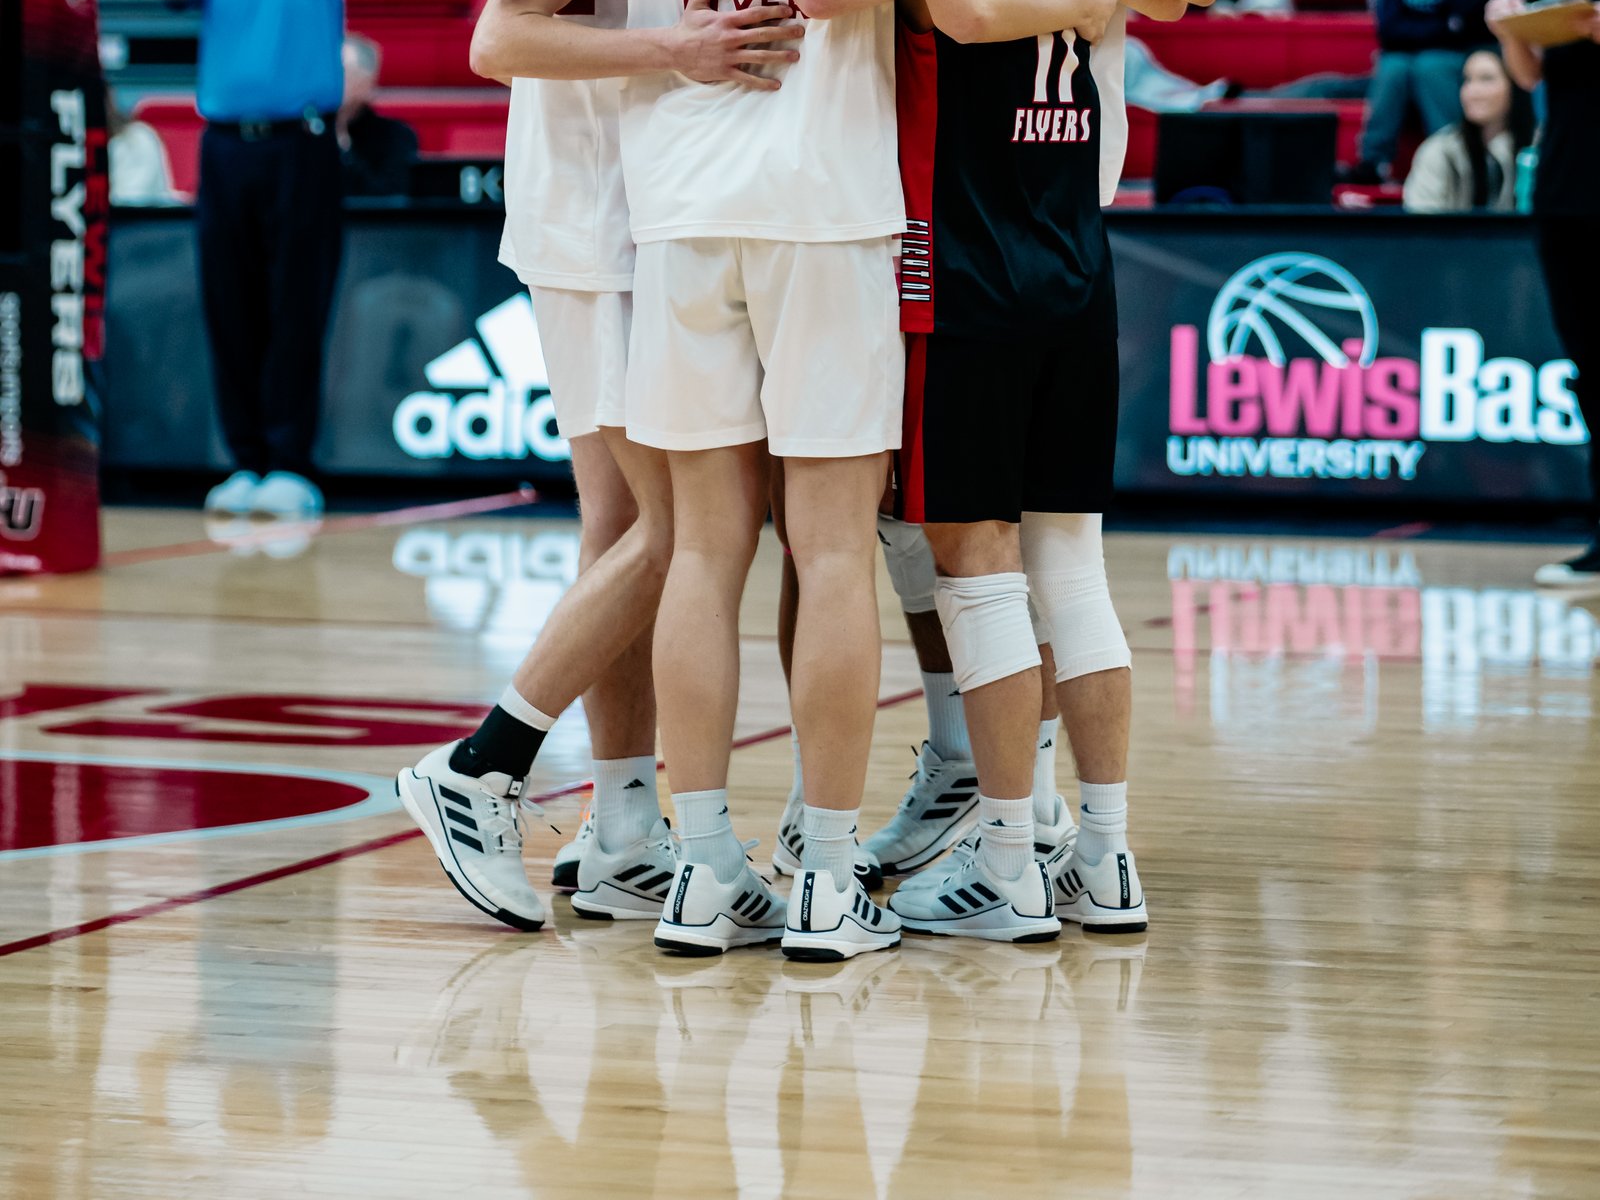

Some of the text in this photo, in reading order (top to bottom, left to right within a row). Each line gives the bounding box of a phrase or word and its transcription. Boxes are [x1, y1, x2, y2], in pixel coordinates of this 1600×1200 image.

[1011, 107, 1092, 143] FLYERS
[51, 88, 85, 405] FLYERS
[1166, 436, 1425, 480] UNIVERSITY
[674, 881, 685, 914] CRAZYFLIGHT
[802, 889, 810, 921] CRAZYFLIGHT
